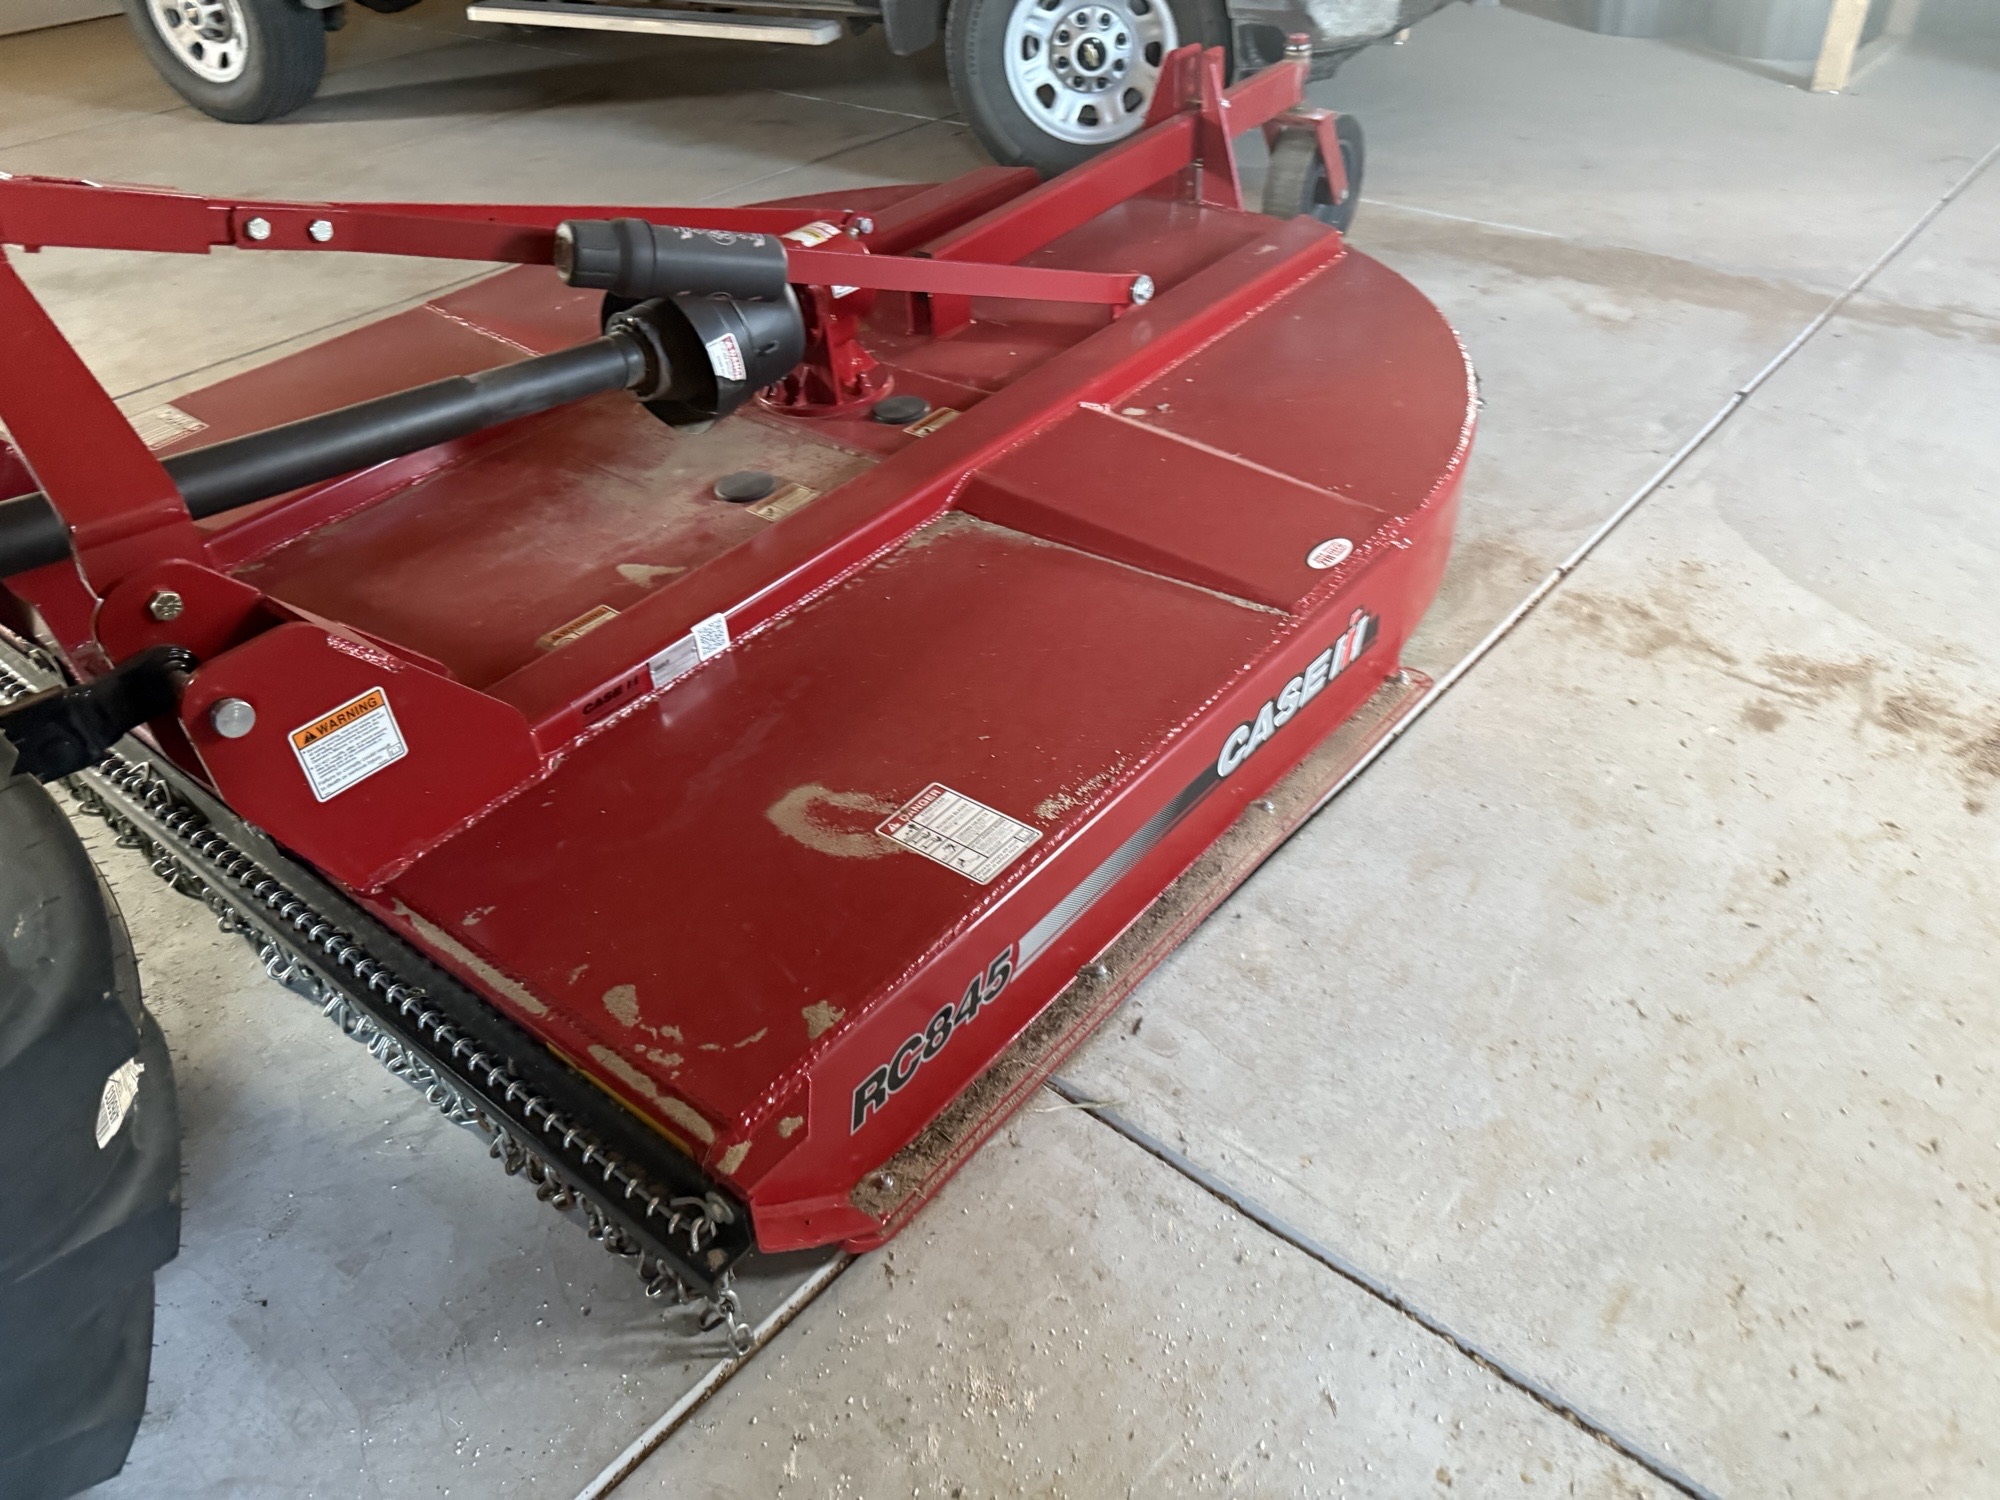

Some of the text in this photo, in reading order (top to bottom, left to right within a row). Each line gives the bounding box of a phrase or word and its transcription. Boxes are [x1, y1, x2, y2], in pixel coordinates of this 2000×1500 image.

[315, 697, 378, 735] WARNING
[582, 685, 624, 715] CASE
[899, 789, 942, 822] DANGER
[850, 943, 1014, 1136] RC845
